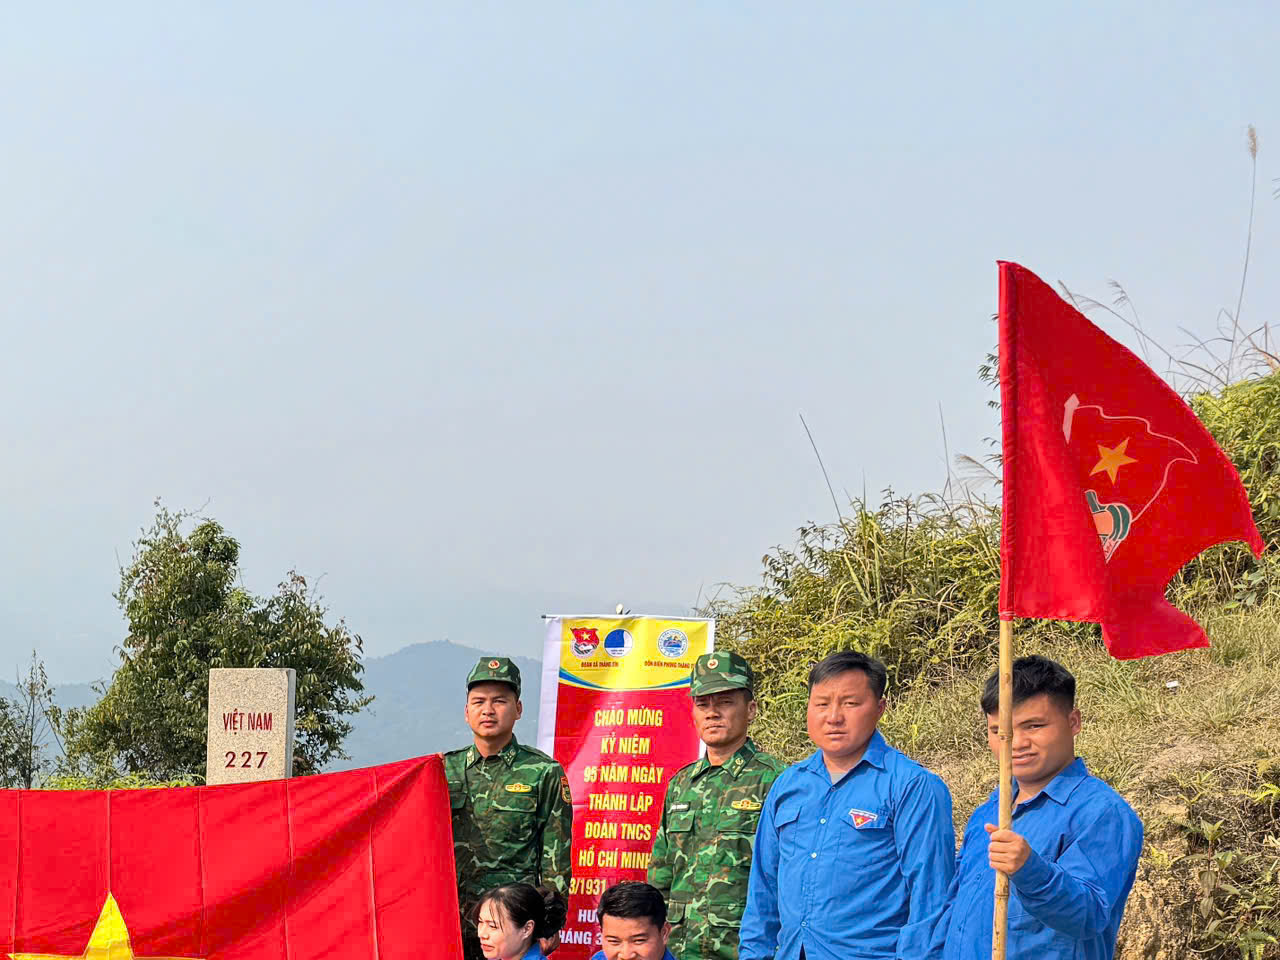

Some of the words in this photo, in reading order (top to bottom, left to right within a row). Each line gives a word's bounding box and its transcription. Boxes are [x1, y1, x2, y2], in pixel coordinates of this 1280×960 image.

[222, 708, 245, 735] VIỆT
[247, 712, 273, 732] NAM
[594, 705, 624, 727] CHÀO
[627, 705, 663, 727] MỪNG
[601, 732, 616, 754] KỶ
[618, 733, 651, 758] NIỆM
[583, 765, 598, 783] 95
[600, 762, 629, 783] NĂM
[631, 763, 664, 784] NGÀY
[588, 790, 627, 811] THÀNH
[629, 791, 653, 816] LẬP
[584, 819, 618, 840] ĐOÀN
[620, 823, 652, 841] TNCS
[578, 844, 595, 867] HỒ
[597, 847, 619, 868] CHÍ
[568, 877, 607, 895] 3/1931
[578, 908, 600, 923] HƯ
[559, 928, 593, 945] HÁNG
